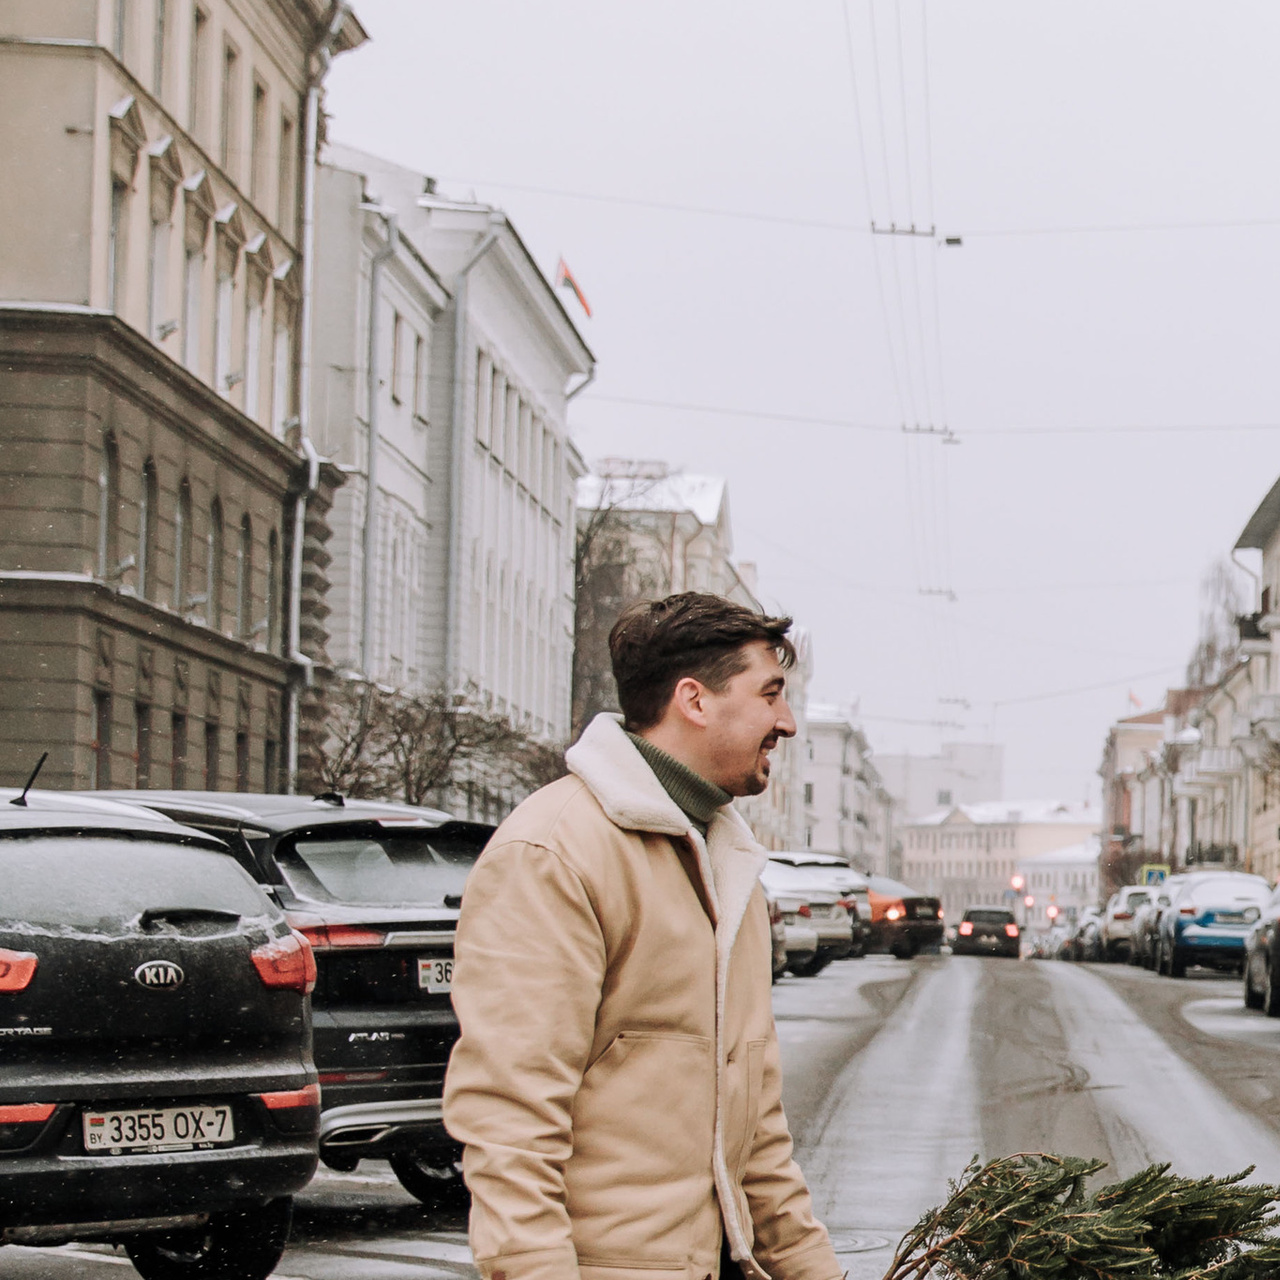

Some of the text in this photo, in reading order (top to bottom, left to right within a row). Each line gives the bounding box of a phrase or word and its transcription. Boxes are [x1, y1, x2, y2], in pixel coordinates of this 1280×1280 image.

[145, 967, 178, 985] KIA
[109, 1113, 165, 1143] 3355
[89, 1133, 103, 1145] BY
